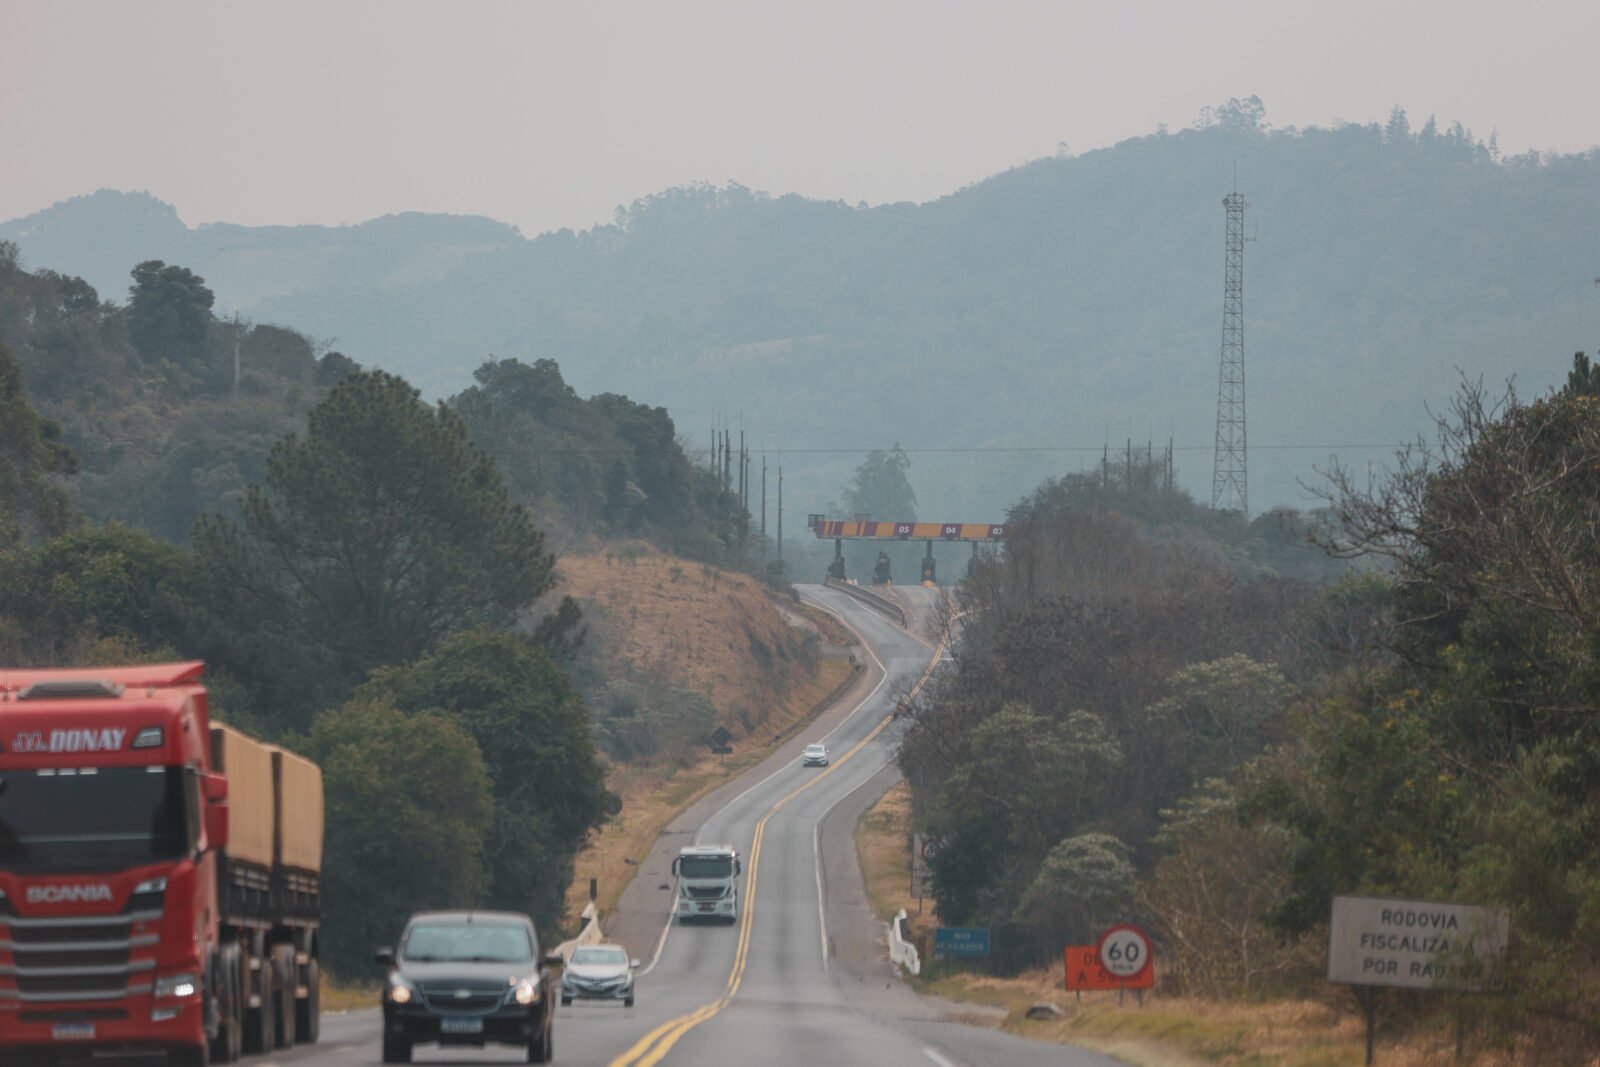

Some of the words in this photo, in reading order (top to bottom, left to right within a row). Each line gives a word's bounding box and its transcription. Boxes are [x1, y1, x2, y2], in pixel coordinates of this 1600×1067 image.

[945, 526, 956, 534] 04
[27, 884, 113, 903] SCANIA
[1381, 909, 1458, 930] RODOVIA
[1108, 941, 1140, 963] 60
[1362, 957, 1398, 976] POR
[1077, 971, 1087, 984] A
